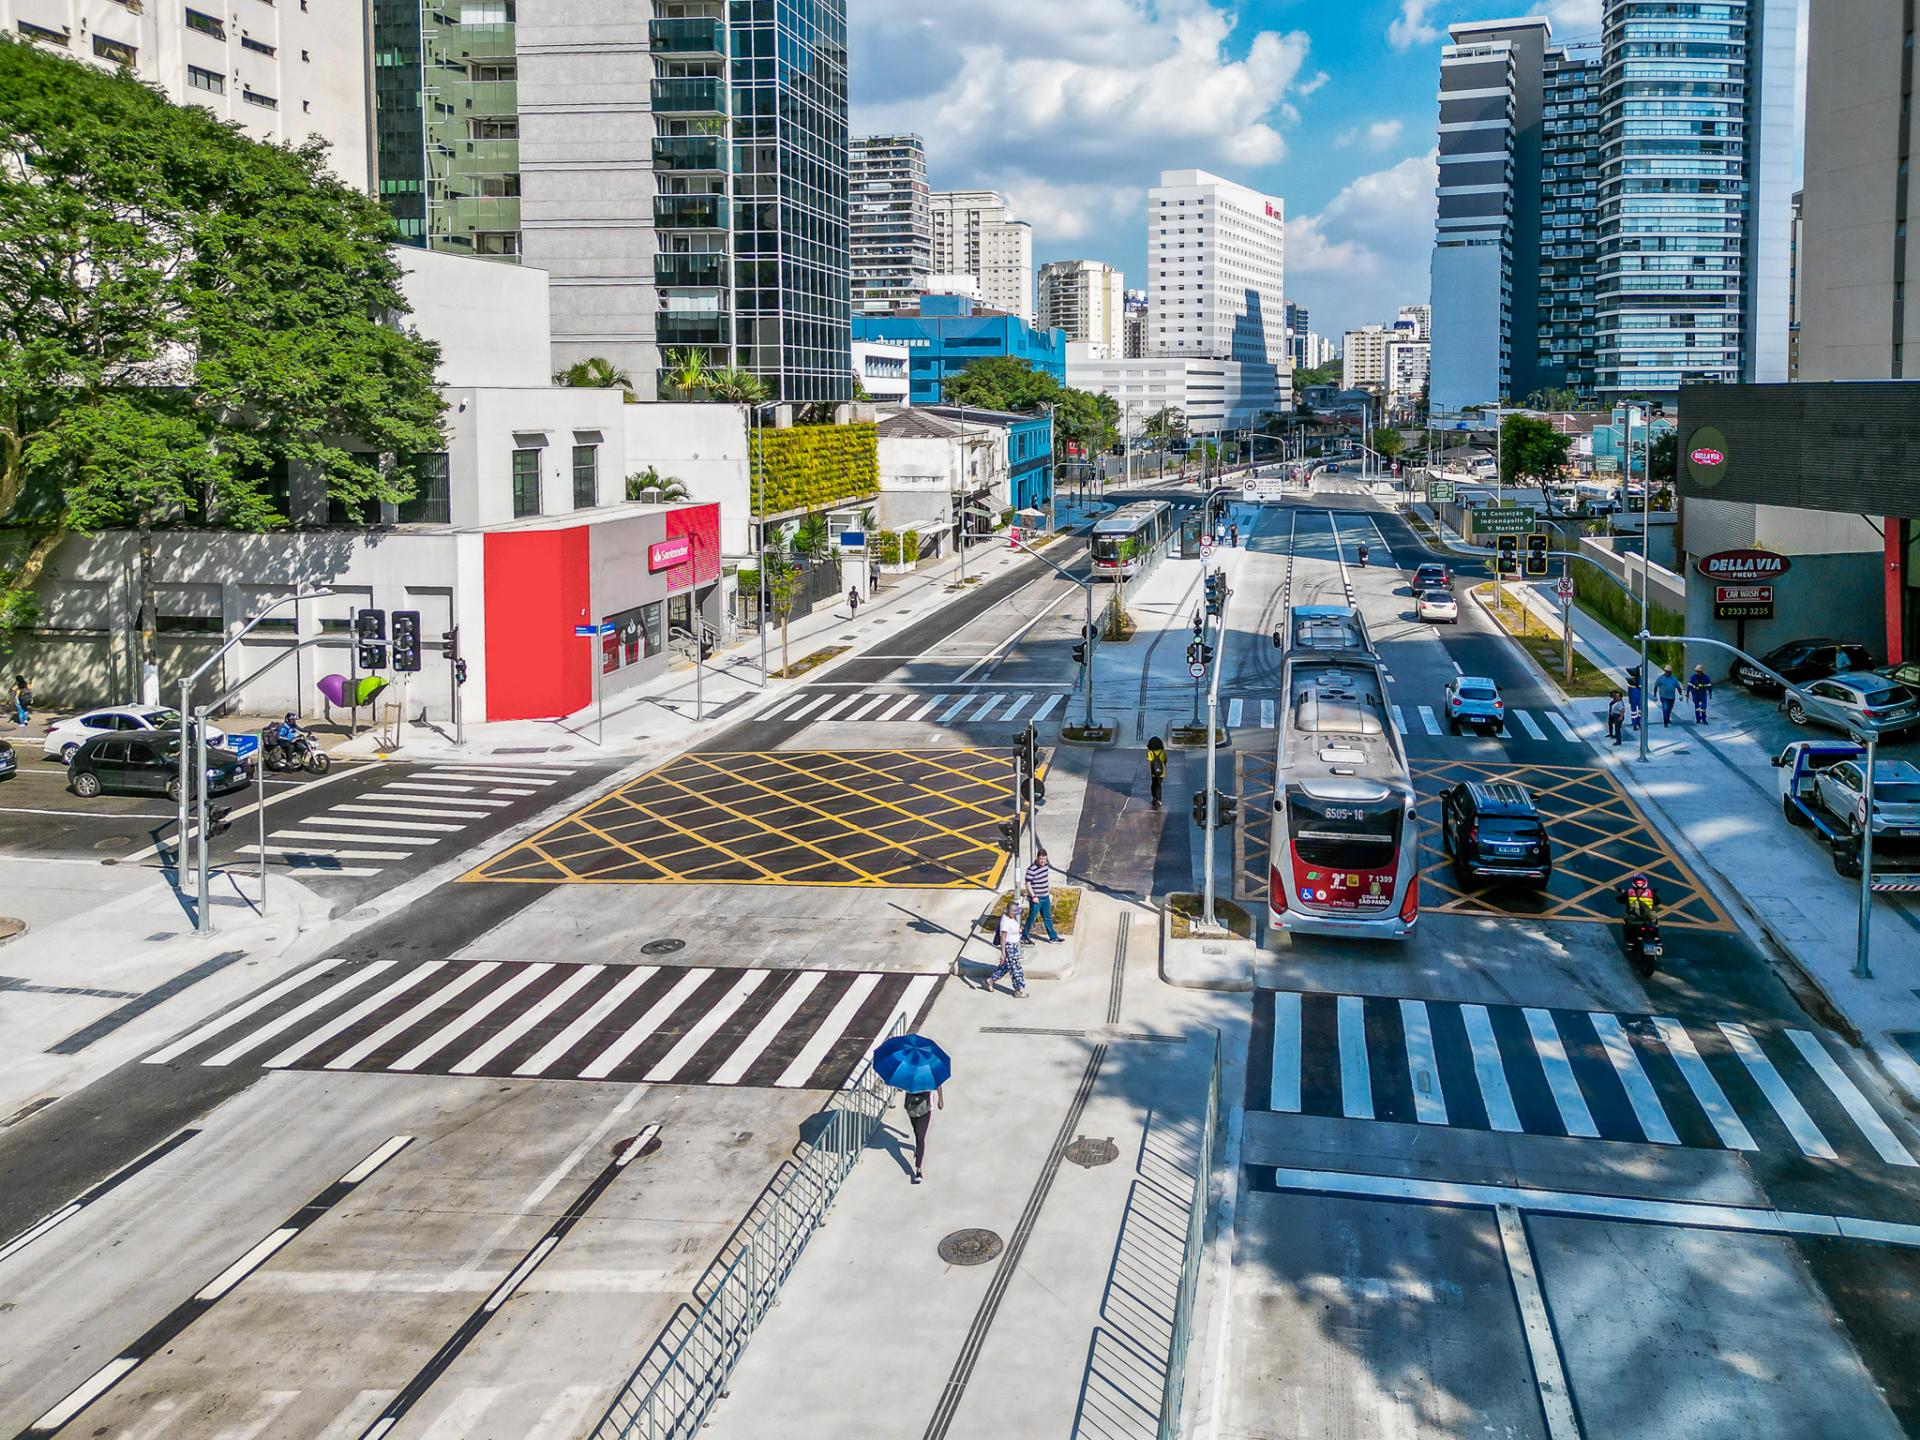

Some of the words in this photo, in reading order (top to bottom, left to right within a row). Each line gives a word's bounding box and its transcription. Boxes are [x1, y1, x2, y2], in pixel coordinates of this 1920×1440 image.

[661, 546, 688, 561] Santander
[1709, 558, 1754, 571] DELLA
[1756, 558, 1781, 570] VIA
[1725, 590, 1738, 598] CAR
[1740, 590, 1759, 598] WASH
[1727, 607, 1747, 615] 2333
